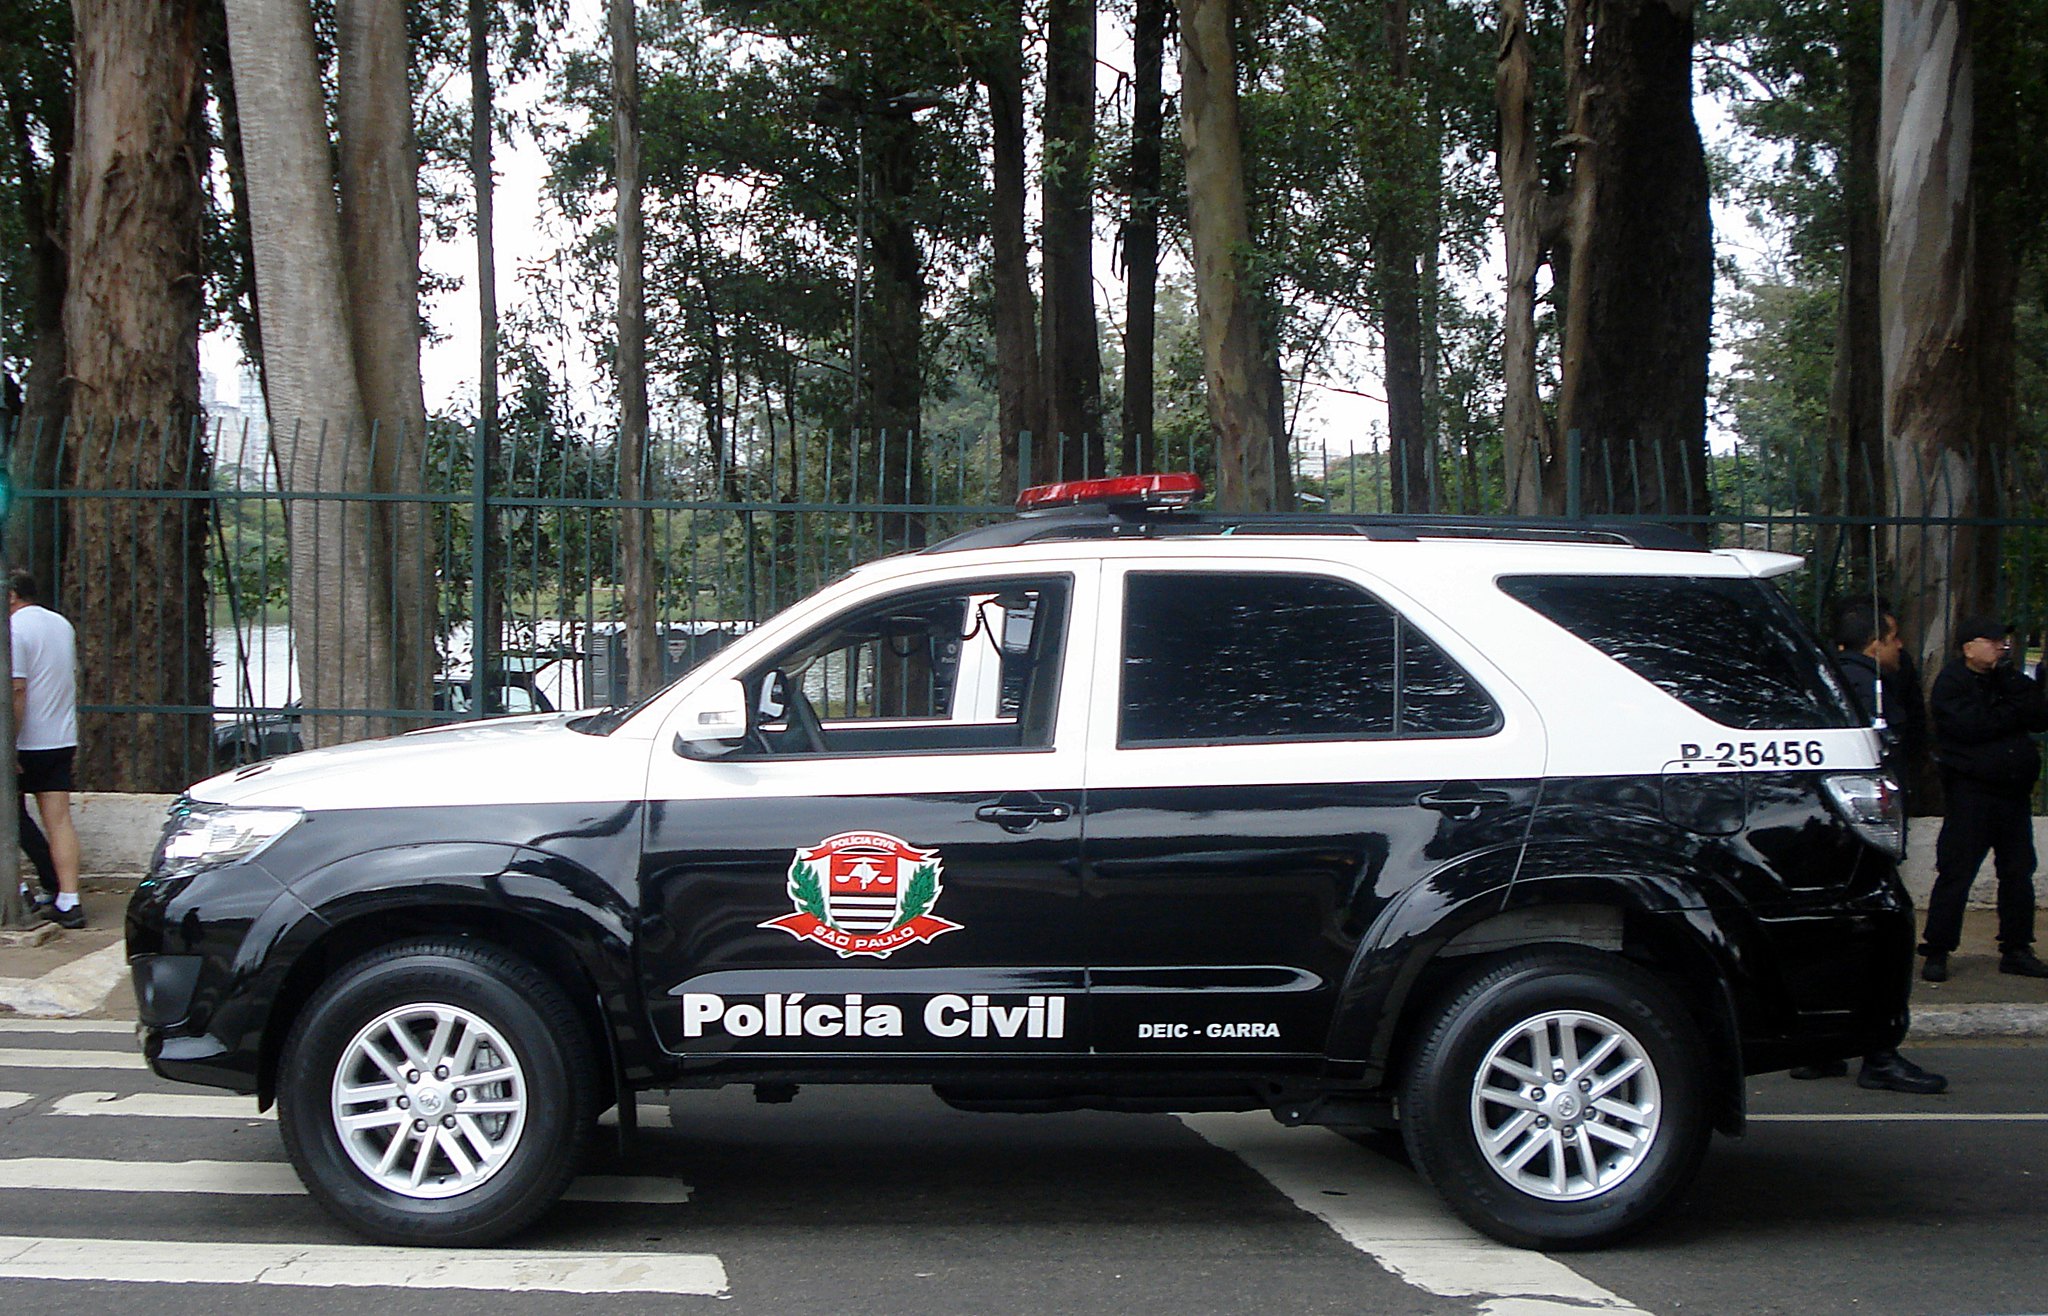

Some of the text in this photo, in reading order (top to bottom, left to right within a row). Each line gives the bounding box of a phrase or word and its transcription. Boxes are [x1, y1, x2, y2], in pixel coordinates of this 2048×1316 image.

[1680, 740, 1824, 768] P-25456
[873, 838, 897, 850] CIVIL
[855, 926, 915, 948] PAULO
[683, 993, 1066, 1038] Polícia Civil
[1138, 1023, 1189, 1038] DEIC
[1206, 1023, 1281, 1038] GARRA
